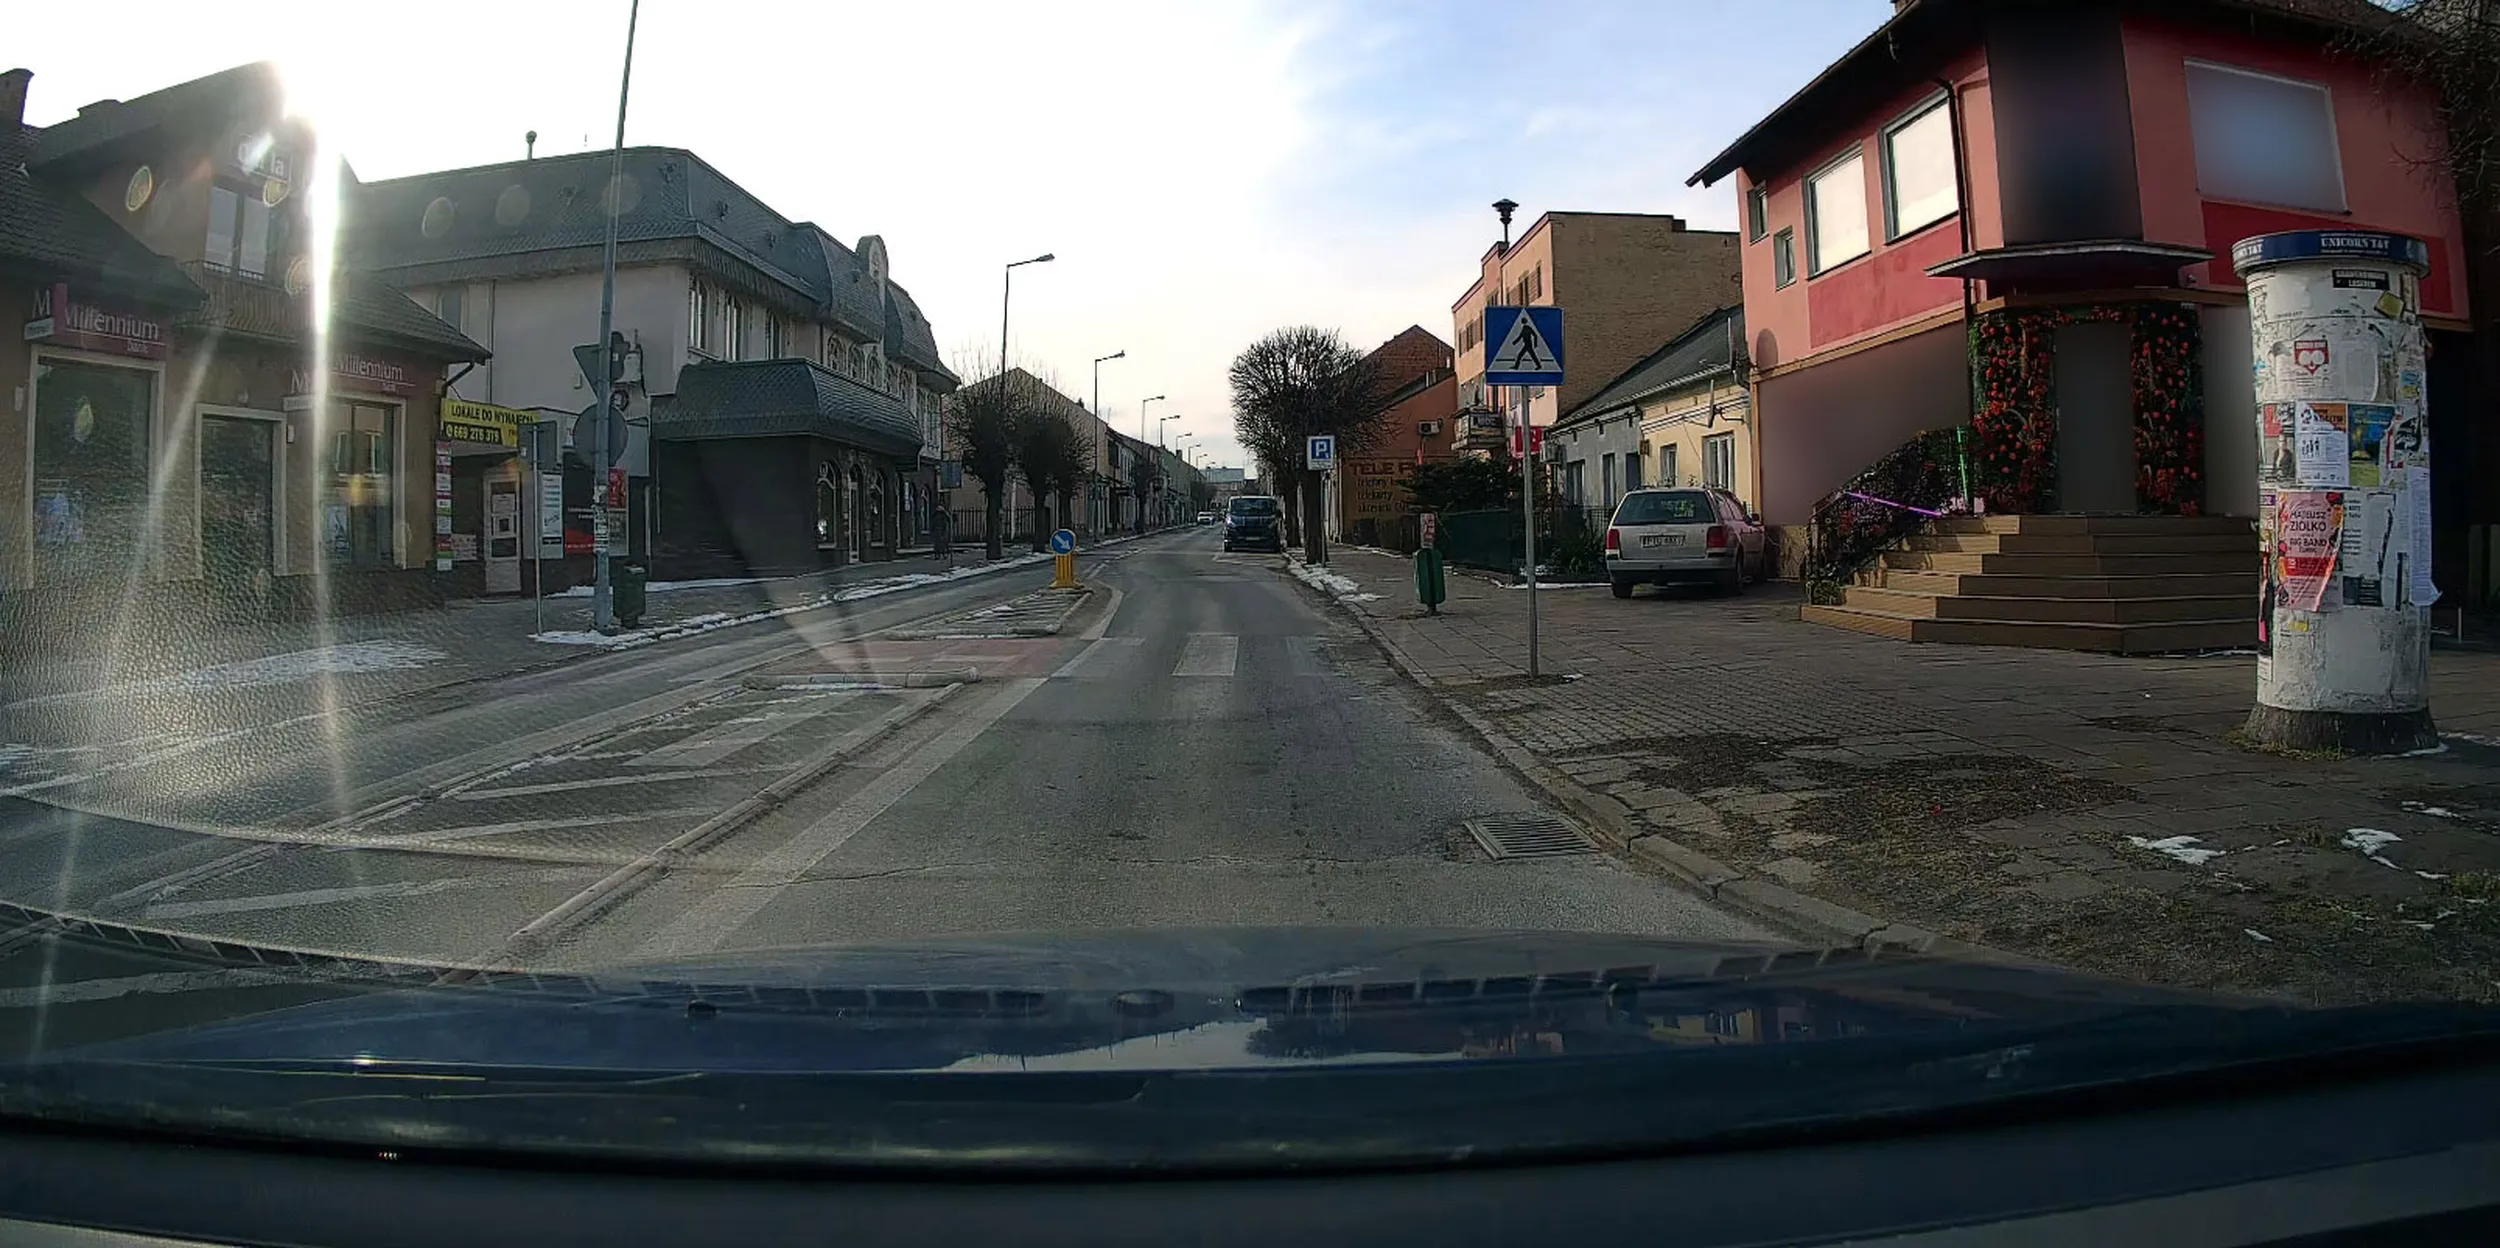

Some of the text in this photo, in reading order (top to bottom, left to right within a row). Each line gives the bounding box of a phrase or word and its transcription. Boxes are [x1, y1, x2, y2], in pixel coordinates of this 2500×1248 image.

[65, 304, 158, 340] Millennium
[482, 410, 493, 420] DO
[1315, 441, 1328, 457] P
